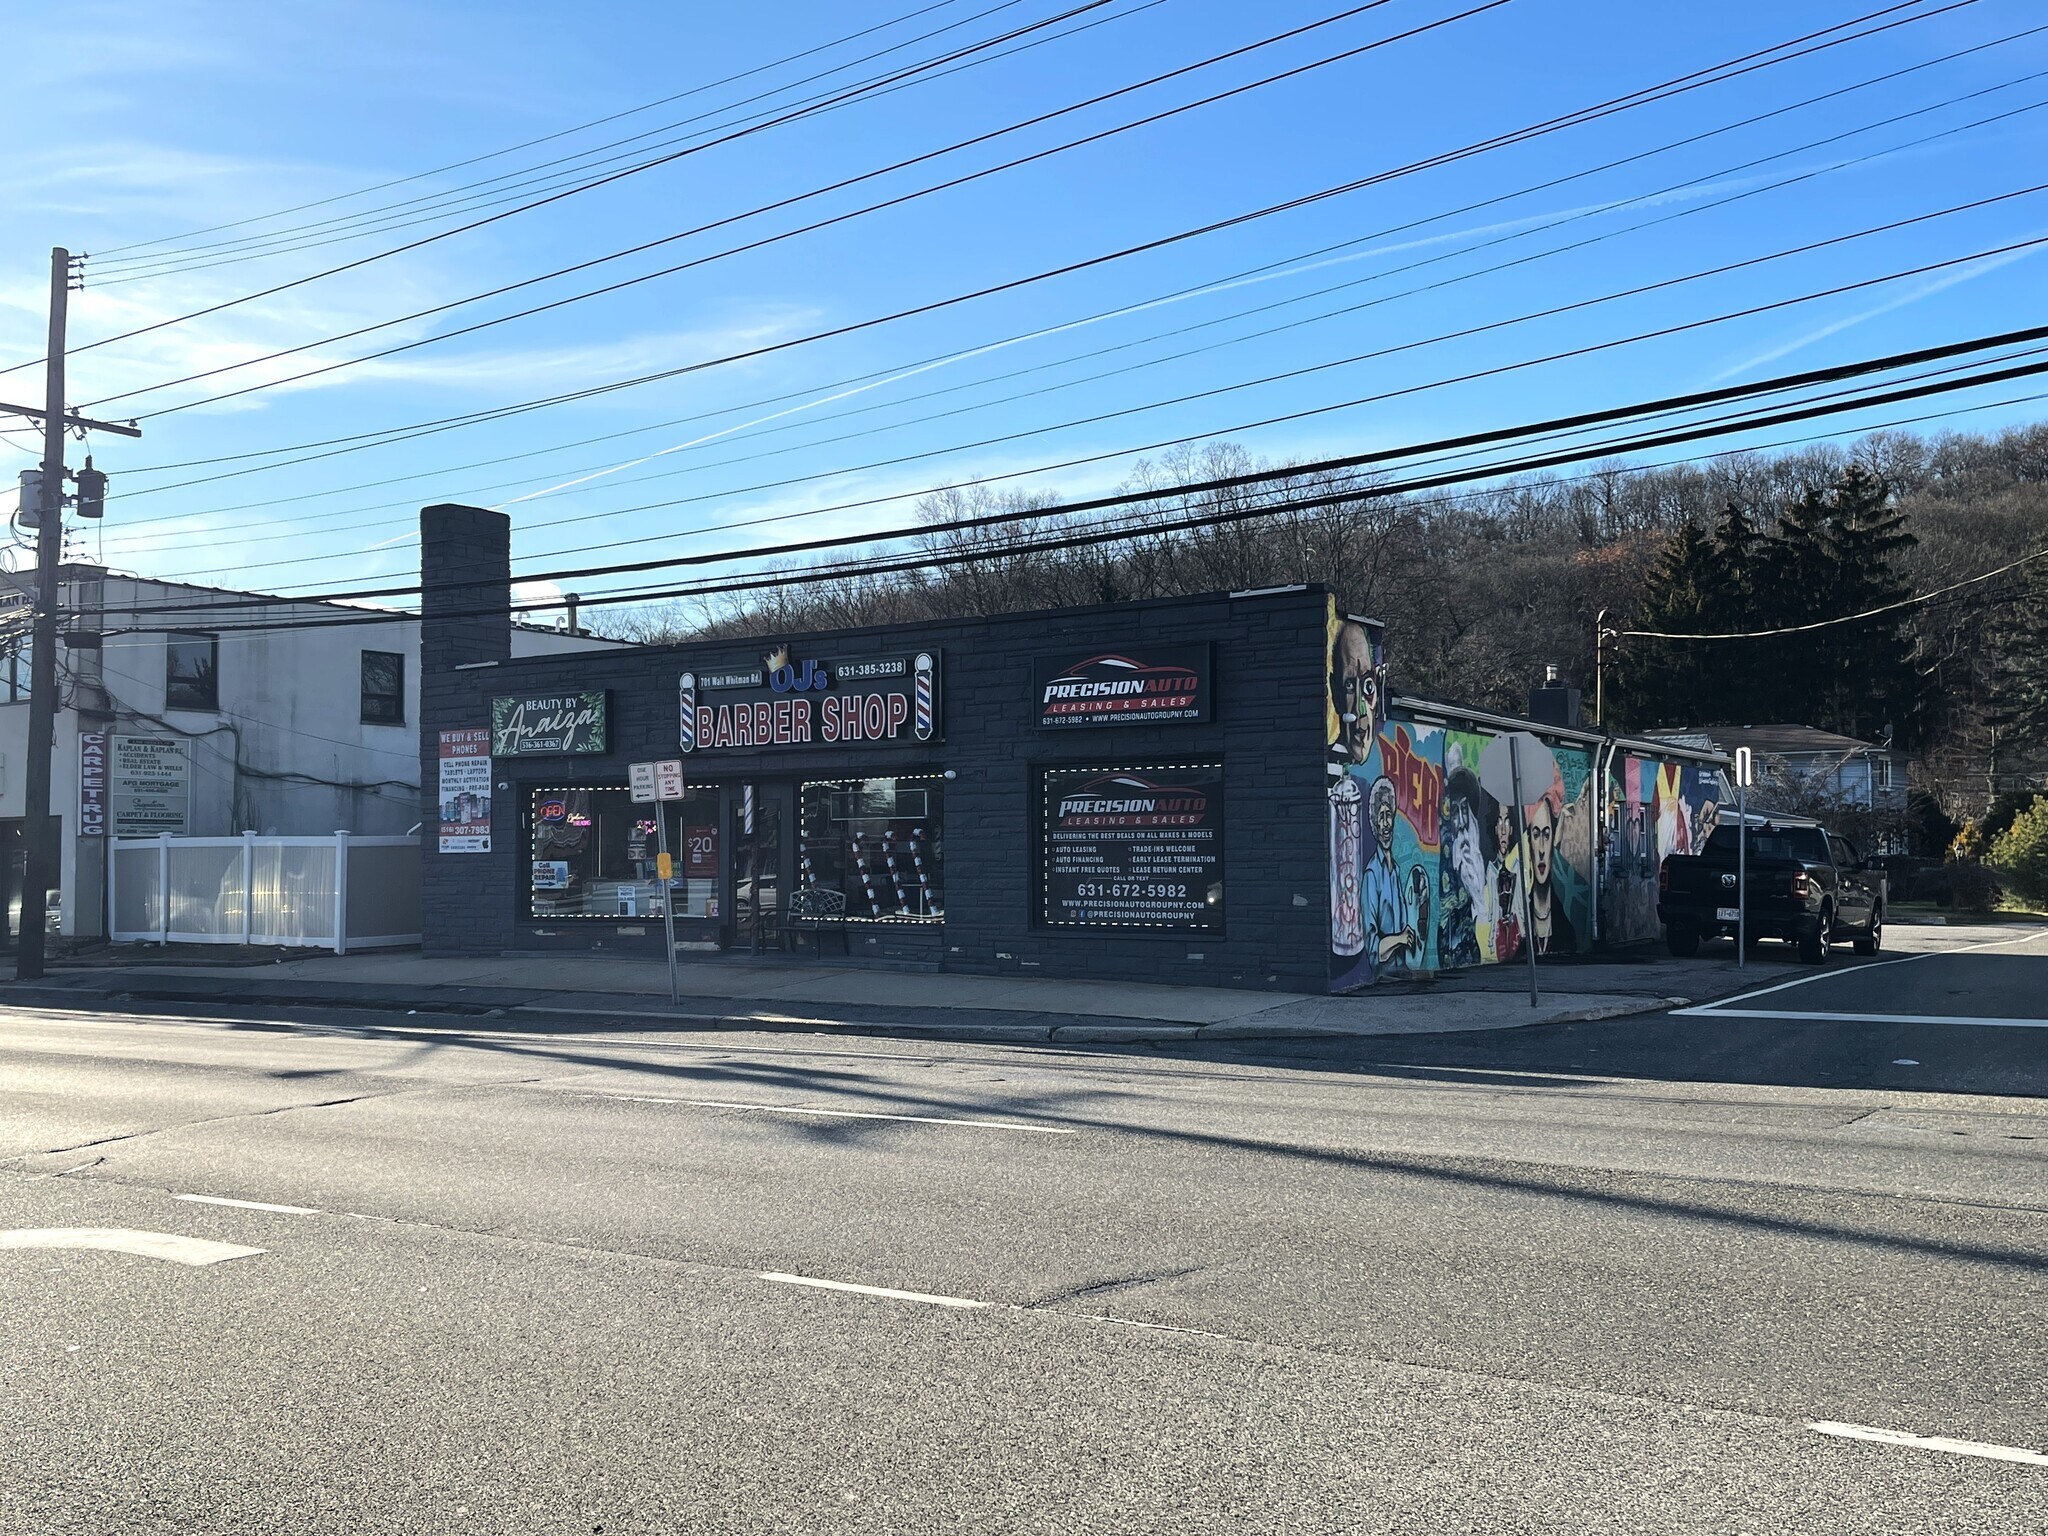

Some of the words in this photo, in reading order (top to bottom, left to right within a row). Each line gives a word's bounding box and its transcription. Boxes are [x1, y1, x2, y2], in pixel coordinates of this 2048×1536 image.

[838, 661, 903, 678] 631-385-3238
[700, 677, 710, 687] 701
[712, 676, 725, 686] Walt
[725, 674, 750, 685] Whitman
[526, 699, 562, 711] BEAUTY
[565, 698, 578, 709] BY
[1053, 701, 1113, 713] LEASING
[1123, 700, 1130, 709] &
[1141, 697, 1187, 708] SALES
[696, 698, 811, 748] BARBER
[821, 692, 908, 742] SHOP
[1042, 715, 1083, 725] 631-672-5982
[441, 734, 451, 743] WE
[452, 732, 465, 743] BUY
[466, 732, 472, 741] &
[473, 731, 490, 741] SELL
[117, 743, 141, 752] KAPLAN
[143, 745, 149, 753] &
[150, 746, 173, 754] KAPLAN
[452, 744, 478, 755] PHONES
[83, 735, 104, 798] CARPET
[663, 764, 674, 773] NO
[658, 772, 681, 780] STOPPING
[540, 804, 566, 817] OPEN
[83, 804, 103, 835] RUG
[1068, 816, 1125, 825] LEASING
[1135, 816, 1141, 824] &
[1152, 815, 1195, 824] SALES
[688, 836, 712, 853] $20
[1173, 855, 1216, 863] TERMINATION
[1077, 883, 1187, 898] 631-672-5982
[1061, 899, 1205, 909] WWW.PRECISIONAUTOGROUPNY.COM
[1087, 910, 1195, 920] @PRECISIONAUTOGROUPNY
